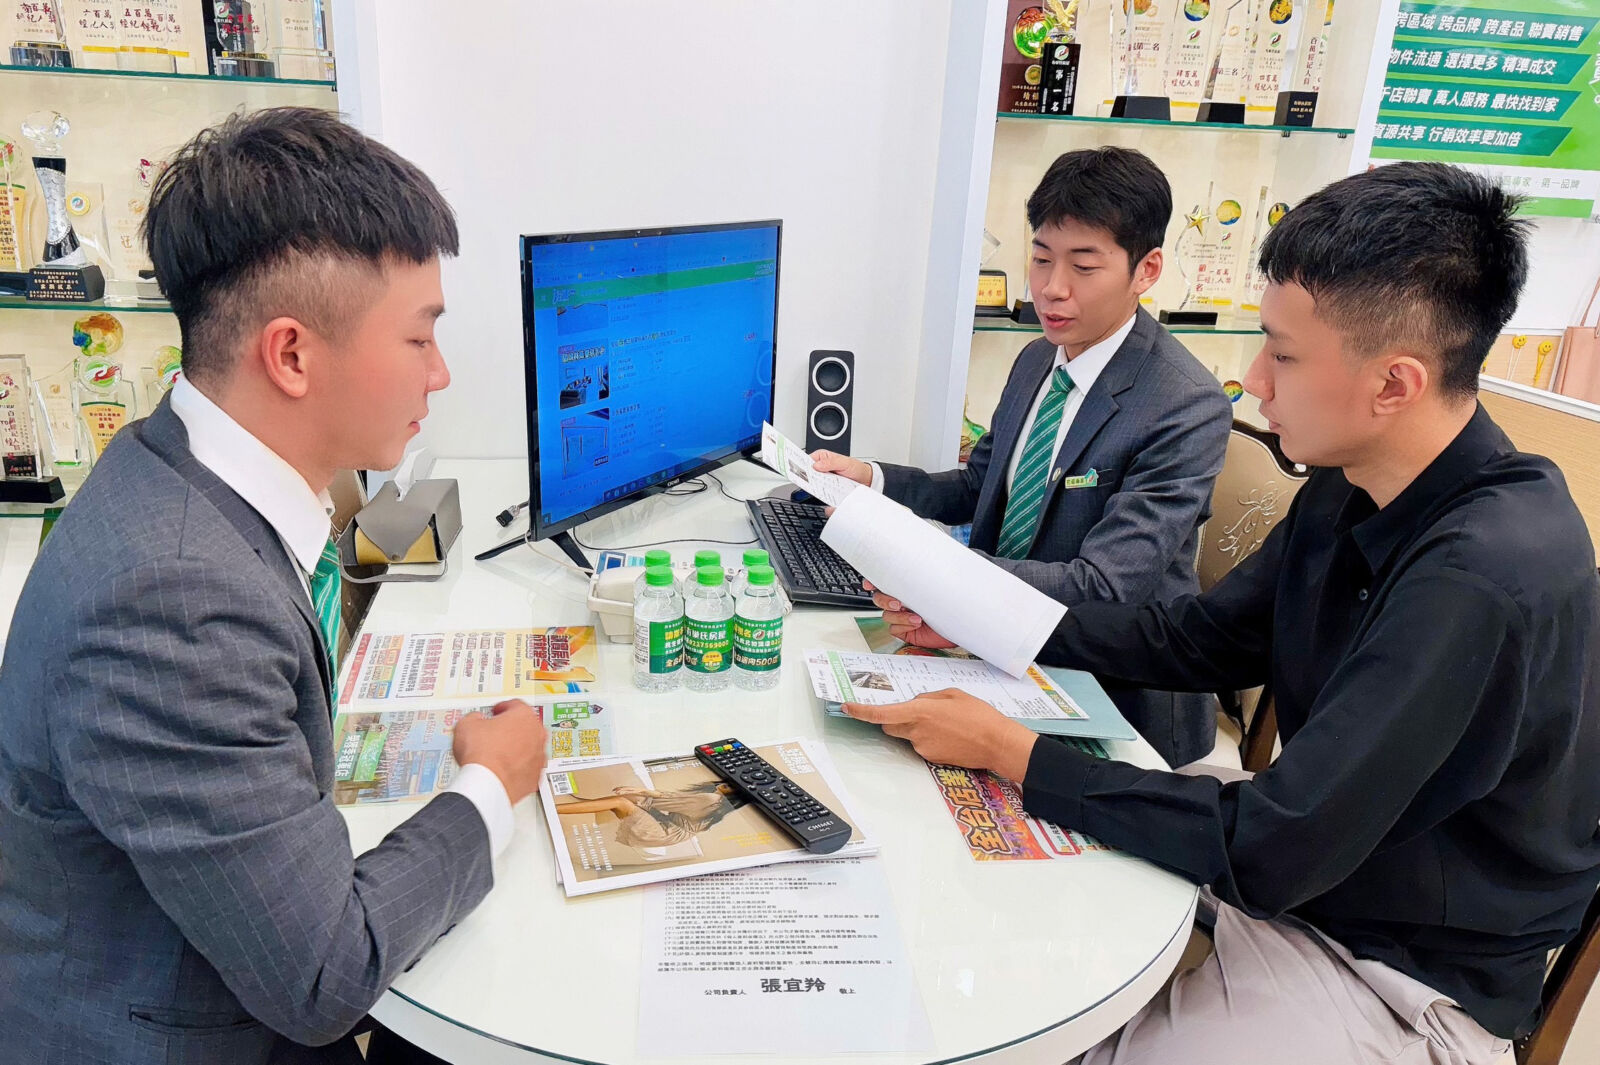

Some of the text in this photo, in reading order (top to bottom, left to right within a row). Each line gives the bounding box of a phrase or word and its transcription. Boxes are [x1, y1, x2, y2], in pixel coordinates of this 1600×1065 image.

[1437, 15, 1482, 34] 跨品牌
[1482, 19, 1525, 37] 跨產品
[1528, 22, 1584, 42] 聯賣銷售
[1388, 48, 1558, 75] 物件流通 選擇更多 精準成交
[1050, 69, 1064, 112] 第一名
[1380, 86, 1560, 113] 千店聯賣 萬人服務 最快找到家
[1428, 126, 1523, 147] 行銷效率更加倍
[807, 820, 834, 831] CHIMEI
[704, 988, 747, 996] 公司負責人
[760, 977, 826, 993] 張宜羚
